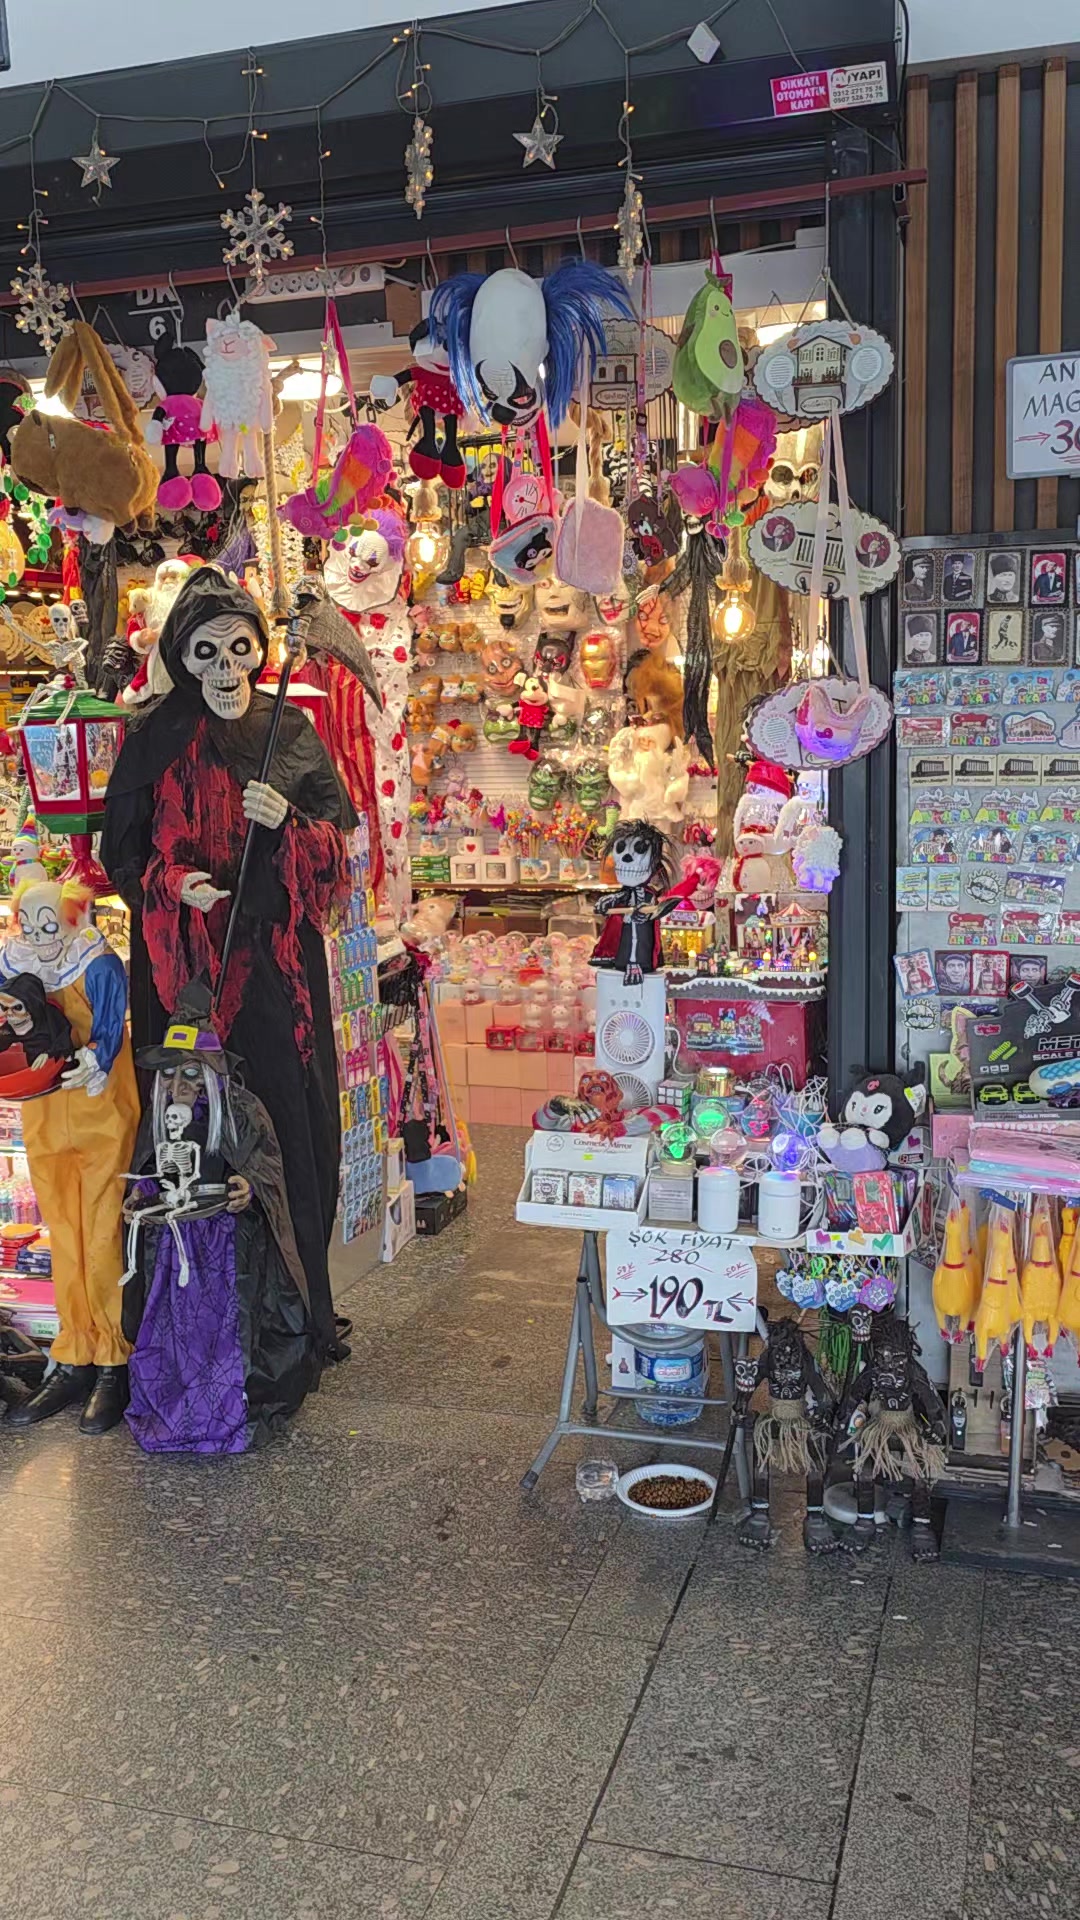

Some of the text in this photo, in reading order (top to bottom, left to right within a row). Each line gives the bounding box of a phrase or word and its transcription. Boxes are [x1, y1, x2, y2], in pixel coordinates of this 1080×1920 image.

[850, 69, 881, 82] YAPI
[832, 89, 849, 97] 0312
[790, 99, 815, 110] KAPI
[149, 316, 167, 341] 6
[951, 735, 1000, 746] ANKARA
[909, 808, 972, 825] ANKARA
[974, 807, 1039, 826] ANKARA
[949, 935, 996, 946] ANKARA
[1033, 1052, 1073, 1061] SCALE
[609, 1141, 633, 1150] Mirror
[628, 1230, 667, 1248] ŞOK
[654, 1249, 701, 1265] 280
[649, 1275, 734, 1324] 190 TL
